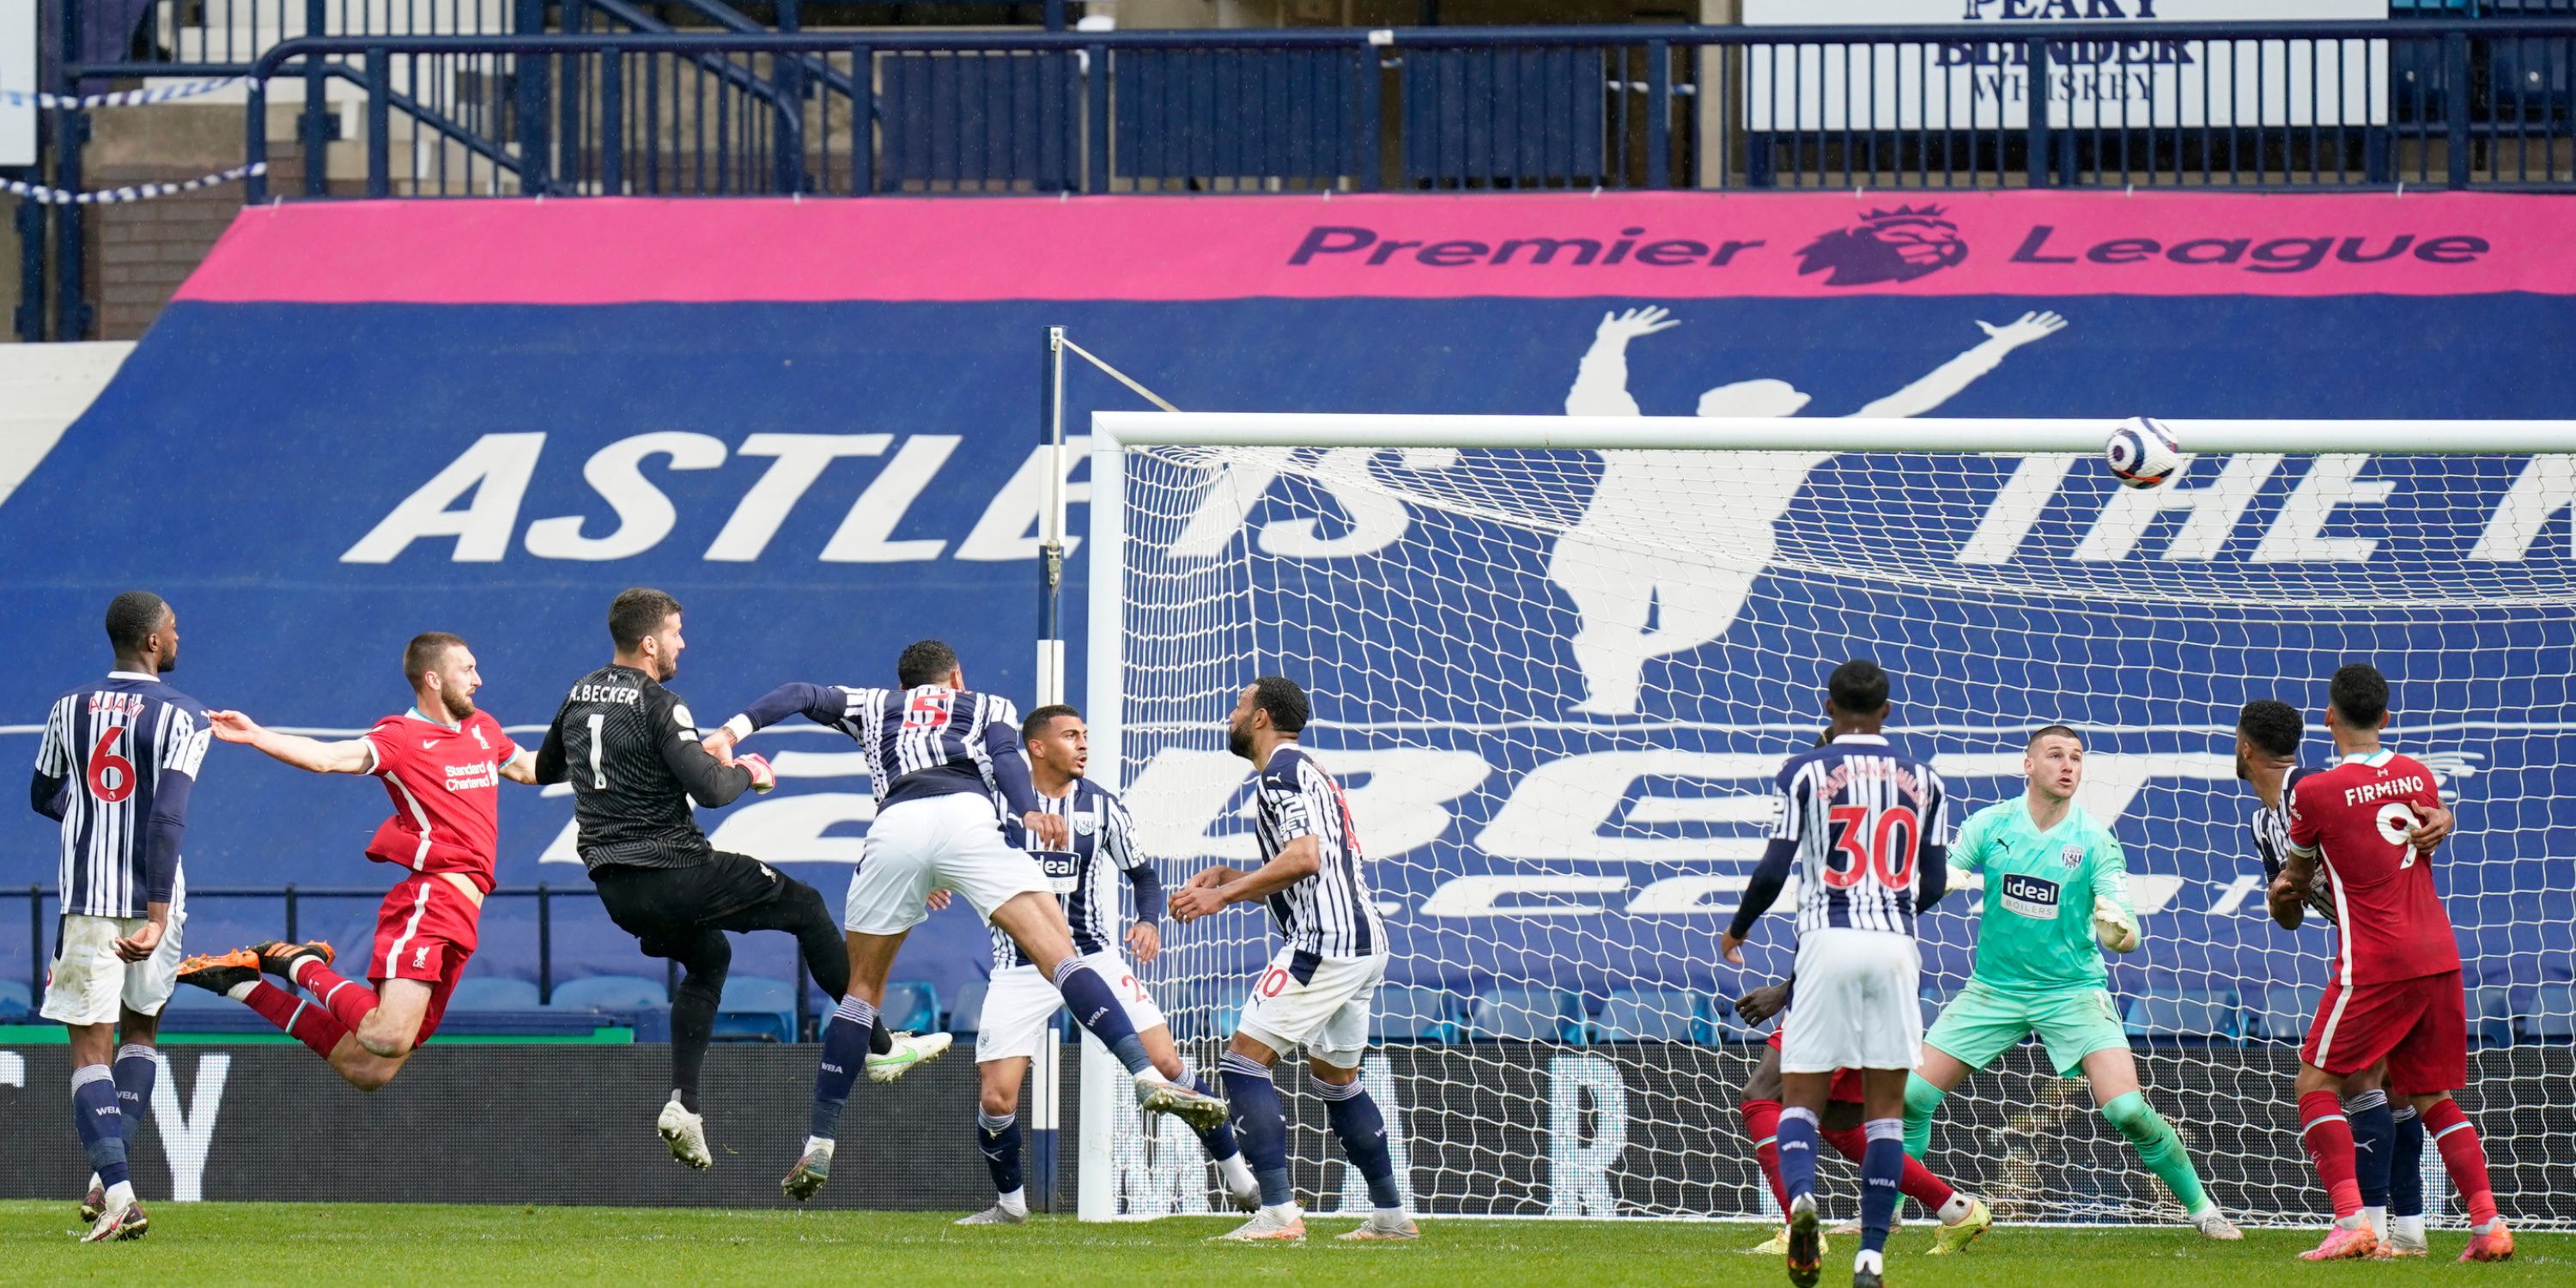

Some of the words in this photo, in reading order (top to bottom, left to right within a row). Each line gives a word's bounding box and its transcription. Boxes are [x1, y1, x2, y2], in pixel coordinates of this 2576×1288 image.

[1287, 225, 1765, 268] Premier
[2010, 223, 2490, 273] League
[339, 431, 1092, 562] ASTLE
[568, 684, 639, 705] A.BECKER
[88, 695, 145, 718] AJAYI
[902, 693, 950, 728] 5
[586, 714, 607, 790] 1
[87, 725, 137, 803] 6
[445, 761, 486, 777] Standard
[446, 775, 490, 791] Chartered
[2344, 775, 2424, 807] FIRMINO
[1275, 795, 1308, 826] 12
[1279, 816, 1309, 833] BET
[2376, 802, 2422, 870] 9
[1822, 805, 1919, 891] 30
[2006, 877, 2056, 902] ideal
[2006, 899, 2052, 915] BOILERS
[1086, 1006, 1109, 1027] WBA
[821, 1062, 844, 1074] WBA
[95, 1105, 122, 1116] WBA
[1782, 1140, 1809, 1151] WBA
[1868, 1177, 1896, 1188] WBA
